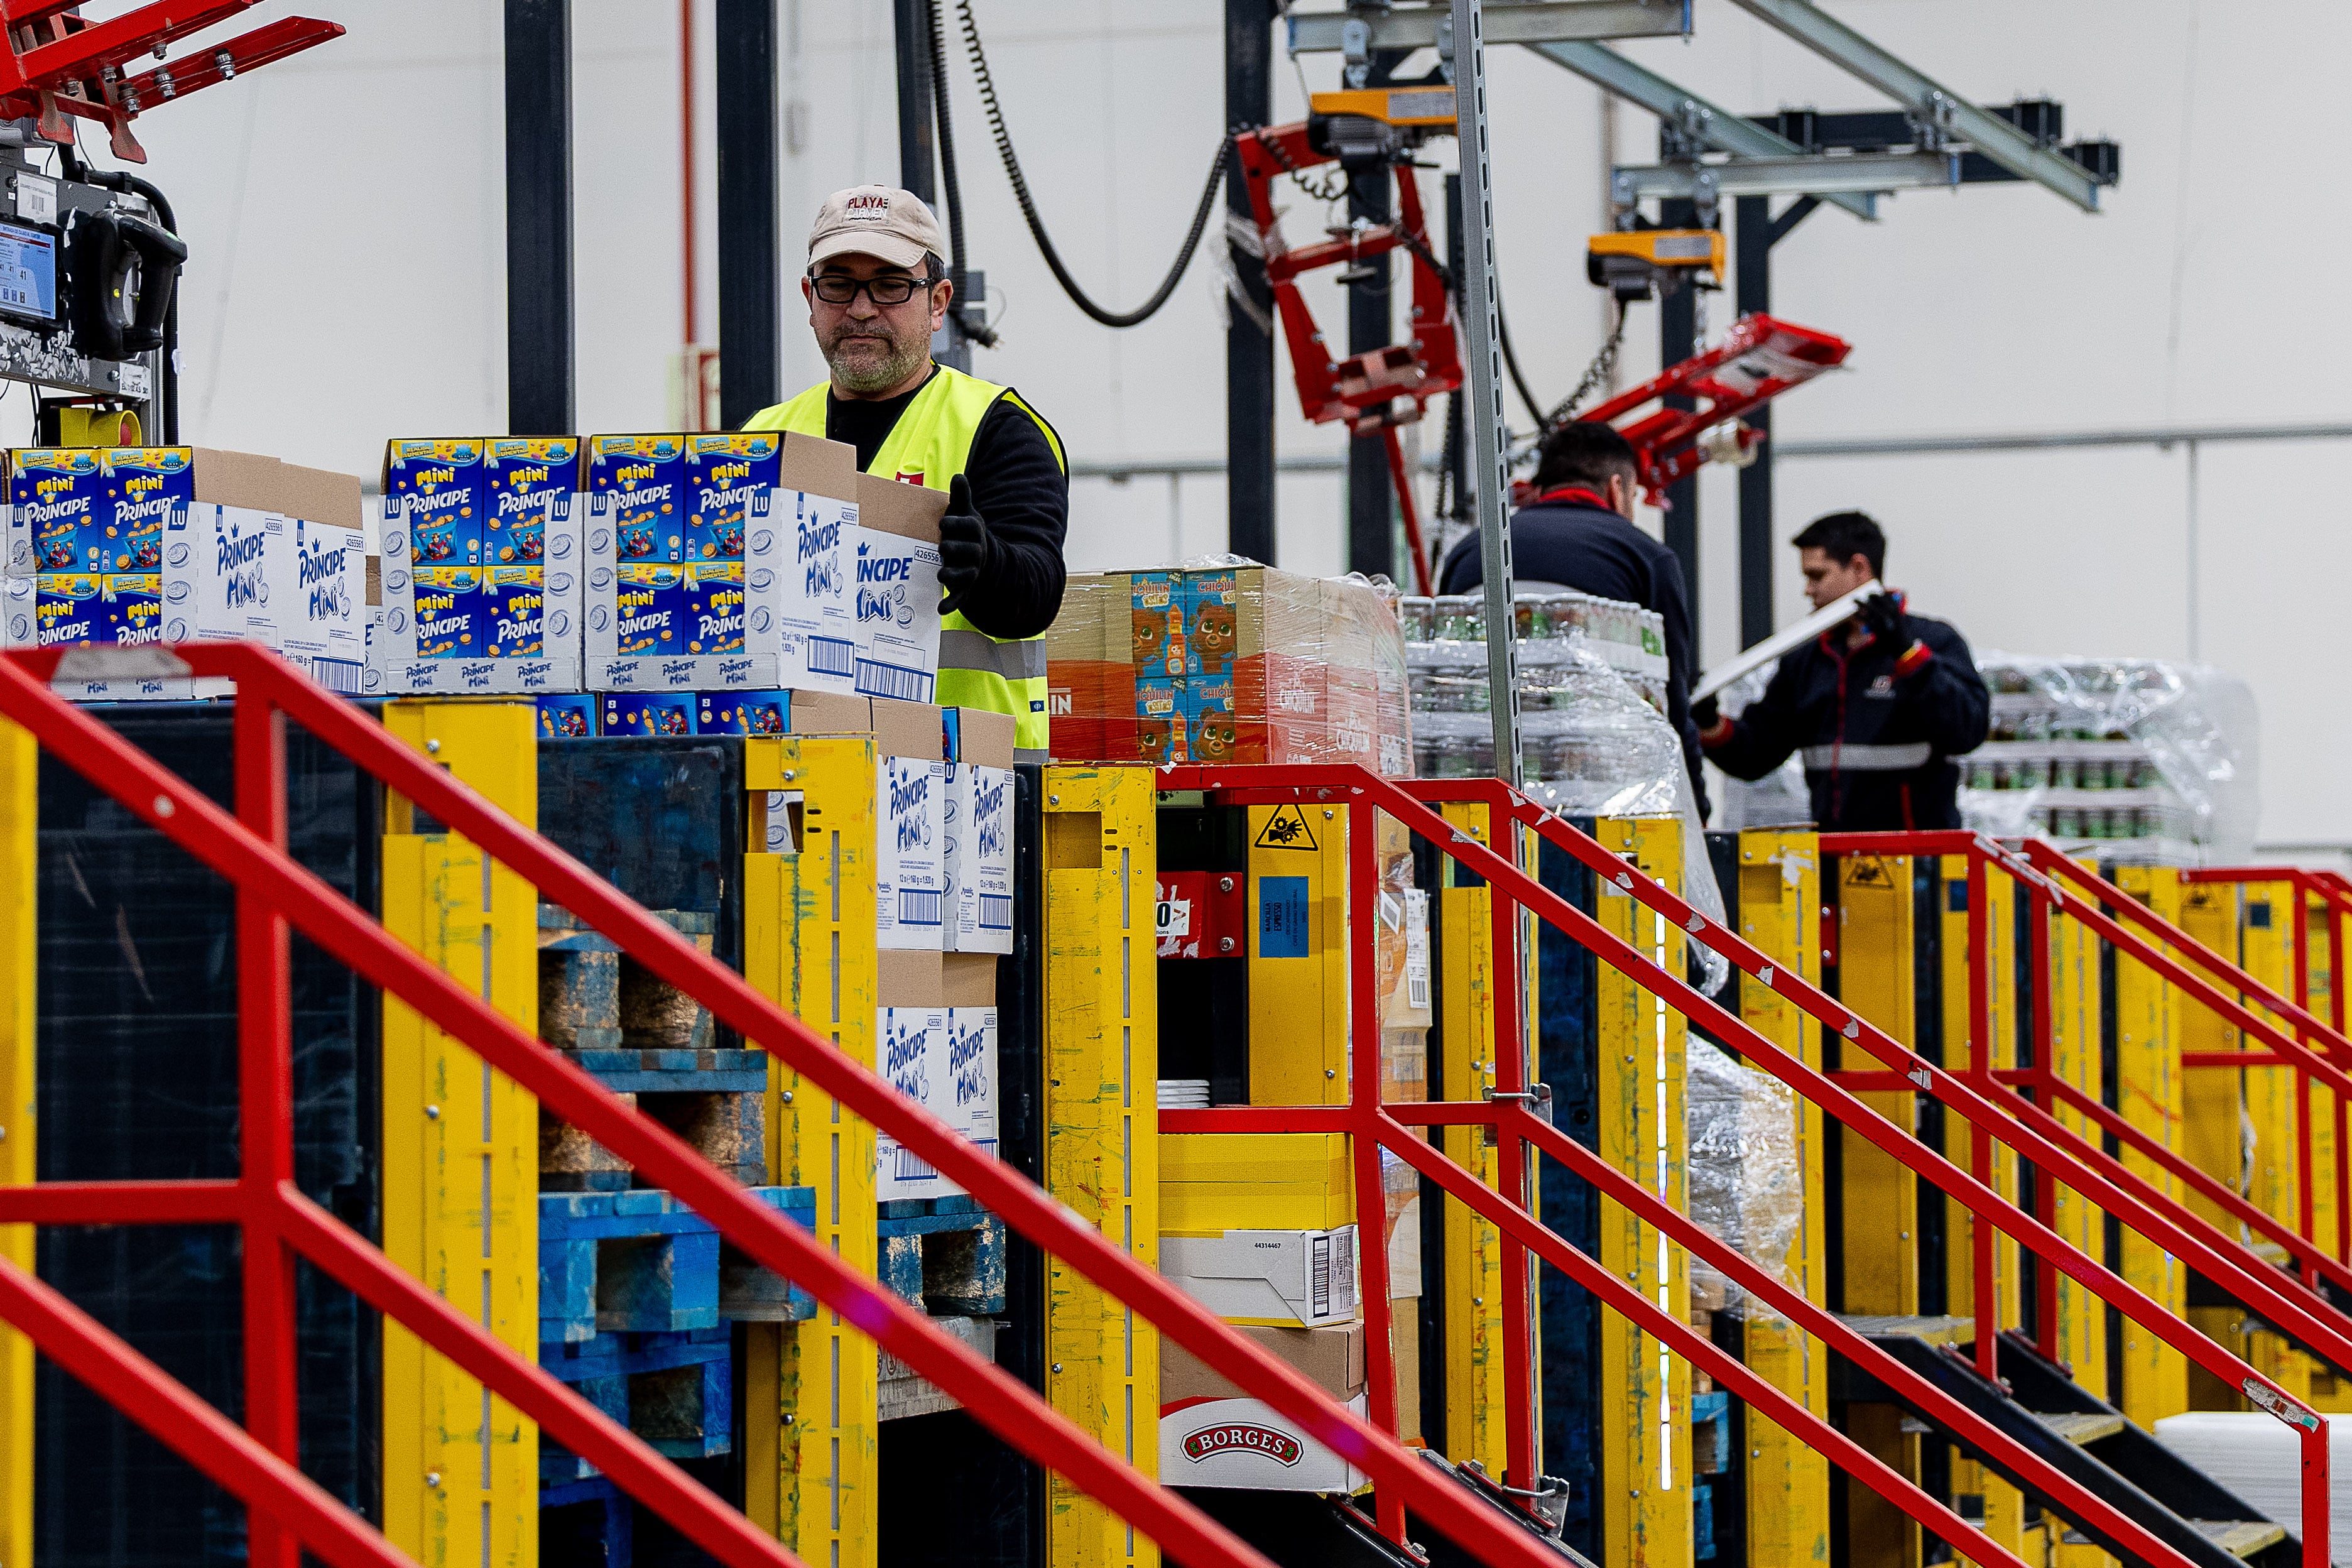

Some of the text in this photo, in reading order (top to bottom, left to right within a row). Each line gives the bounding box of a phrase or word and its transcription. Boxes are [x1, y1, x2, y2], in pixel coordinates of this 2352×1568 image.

[845, 208, 887, 217] CARMEN
[847, 197, 883, 209] PLAYA
[20, 270, 26, 280] 41
[26, 496, 91, 522] PRINCIPE
[387, 500, 399, 514] LU
[405, 487, 471, 514] PRINCIPE
[498, 487, 565, 516] PRINCIP
[555, 501, 568, 516] LU
[594, 496, 605, 511] LU
[606, 484, 672, 510] PRINCIPE
[700, 482, 767, 513] PRINCIP
[754, 497, 768, 512] LU
[15, 507, 23, 526] LU
[114, 495, 180, 525] PRINCIP
[172, 510, 185, 526] LU
[266, 522, 282, 532] 4265561
[217, 531, 264, 576] PRINCIPE
[346, 538, 363, 548] 4265561
[798, 521, 841, 564] PRINCIPE
[298, 548, 346, 589] PRINCIPE
[857, 557, 913, 583] INCIPE
[227, 569, 257, 609] MiNi
[1132, 583, 1170, 594] IQUILIN
[309, 582, 339, 621] MiNi
[38, 621, 90, 646] RINCIPE
[416, 614, 471, 640] RINCIPE
[618, 611, 671, 636] RINCIPE
[406, 664, 439, 679] PRINCIPE
[462, 663, 496, 678] PRINCIPE
[518, 663, 552, 678] PRINCIPE
[606, 661, 640, 677] PRINCIPE
[662, 660, 697, 676] PRINCIPE
[719, 659, 753, 675] PRINCIPE
[1136, 689, 1174, 701] IQUILIN
[945, 765, 953, 779] U
[890, 774, 928, 820] PRINCIPE
[974, 783, 1003, 827] PRINCIPE
[1273, 902, 1282, 931] ESPRESSO
[887, 1028, 927, 1078] PRINCIPE
[949, 1026, 984, 1077] PRINCIPE
[1198, 1429, 1286, 1454] BORGES
